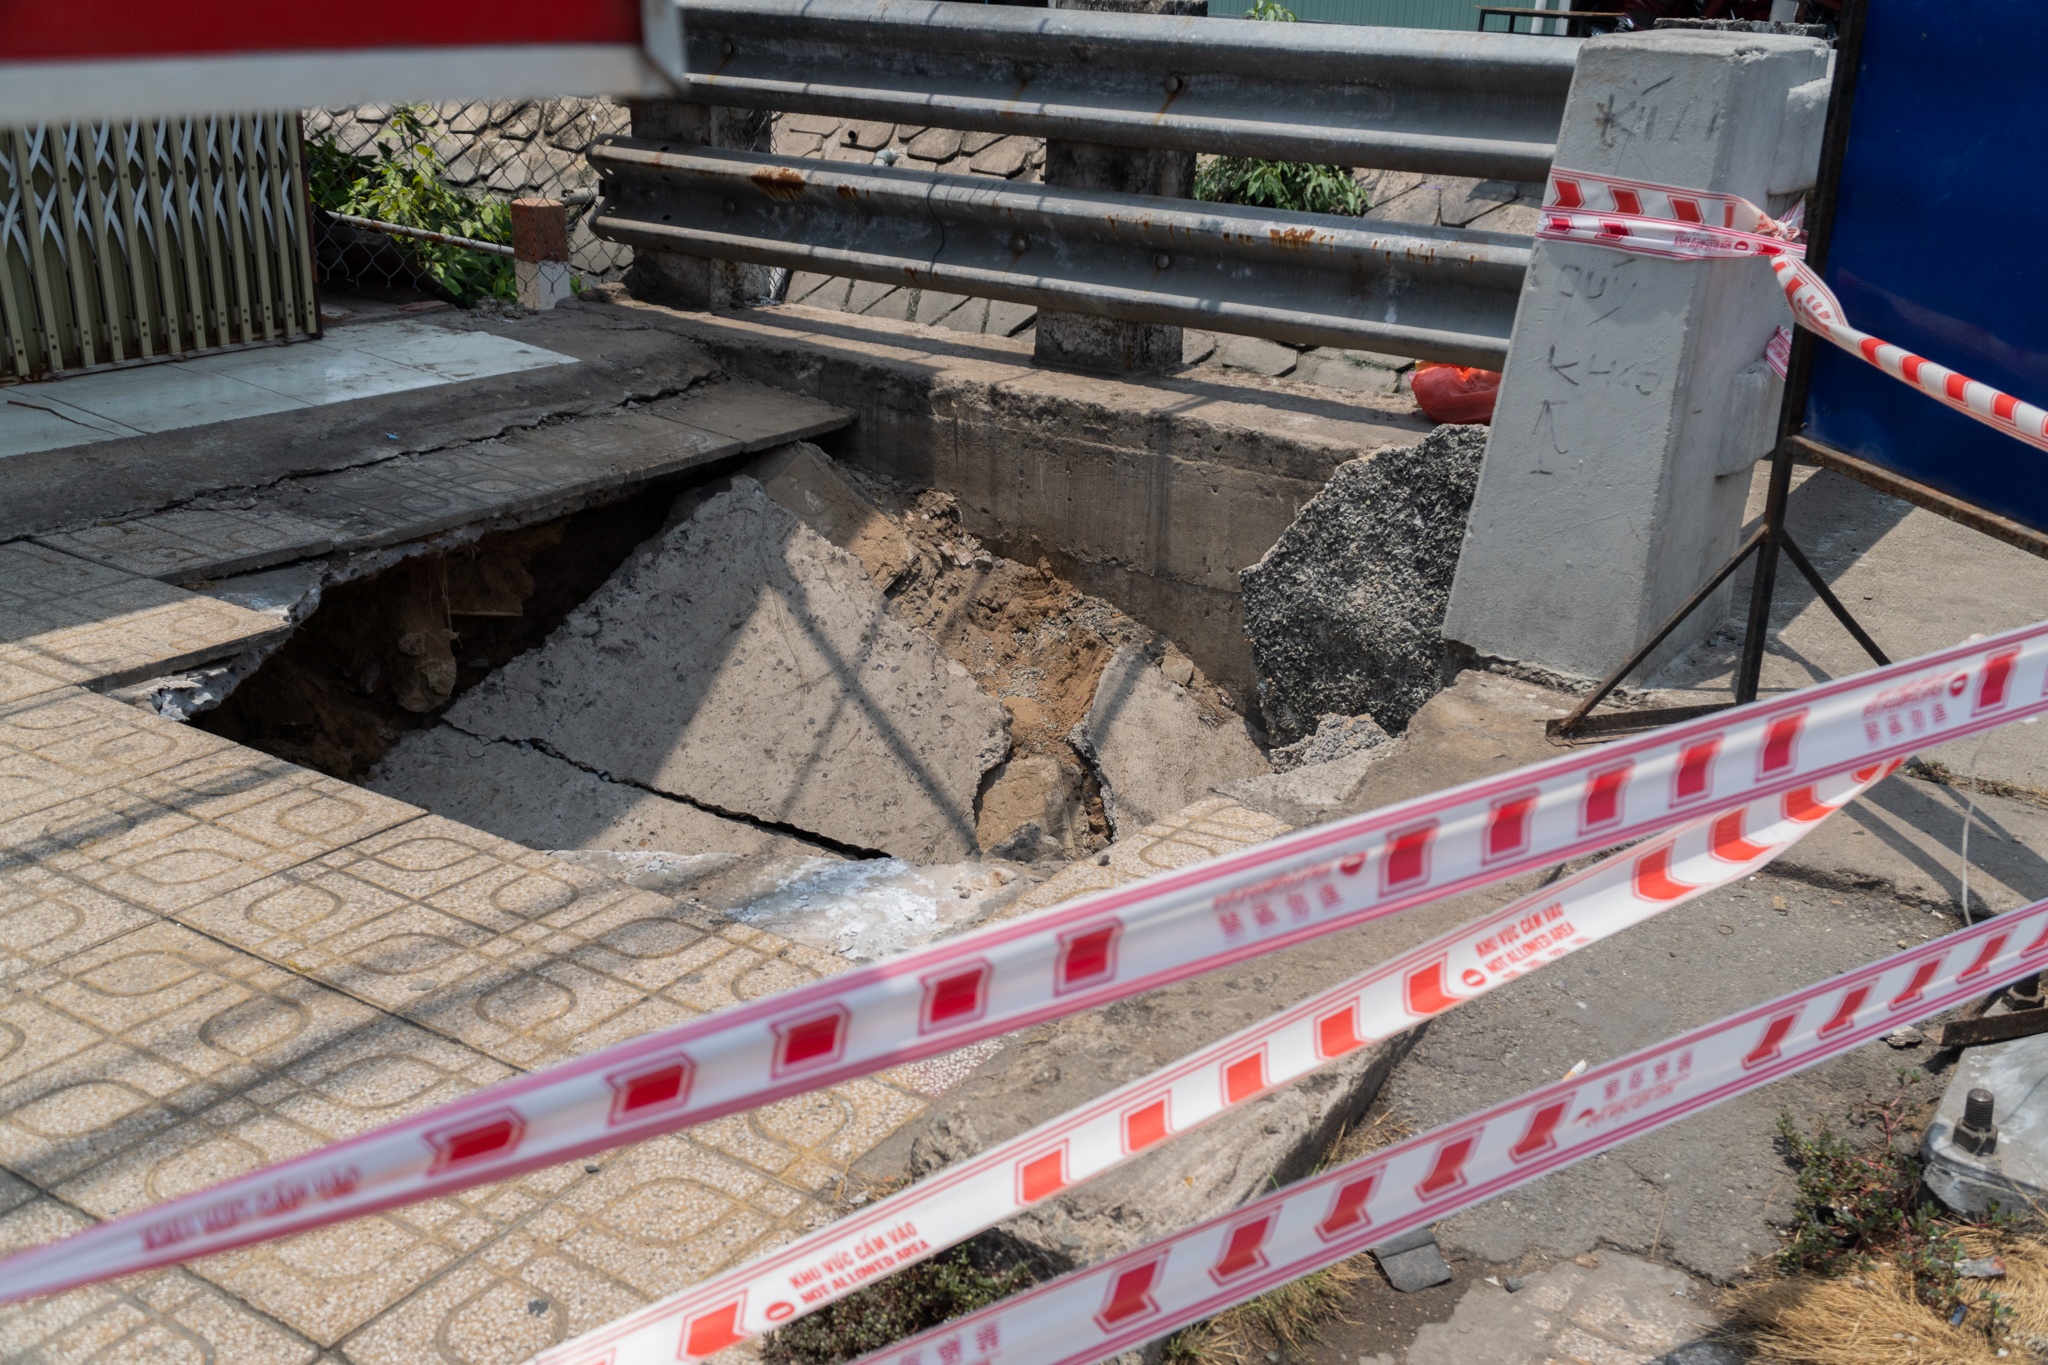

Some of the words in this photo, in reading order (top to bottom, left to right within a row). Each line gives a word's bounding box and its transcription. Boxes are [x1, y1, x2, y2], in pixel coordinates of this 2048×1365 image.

[1506, 933, 1553, 963] ALLOWED
[789, 1265, 822, 1290] KHU
[854, 1232, 888, 1261] CẤM
[886, 1220, 918, 1244] VÀO
[801, 1283, 830, 1304] NOT
[832, 1255, 896, 1290] ALLOWED
[895, 1239, 930, 1263] AREA
